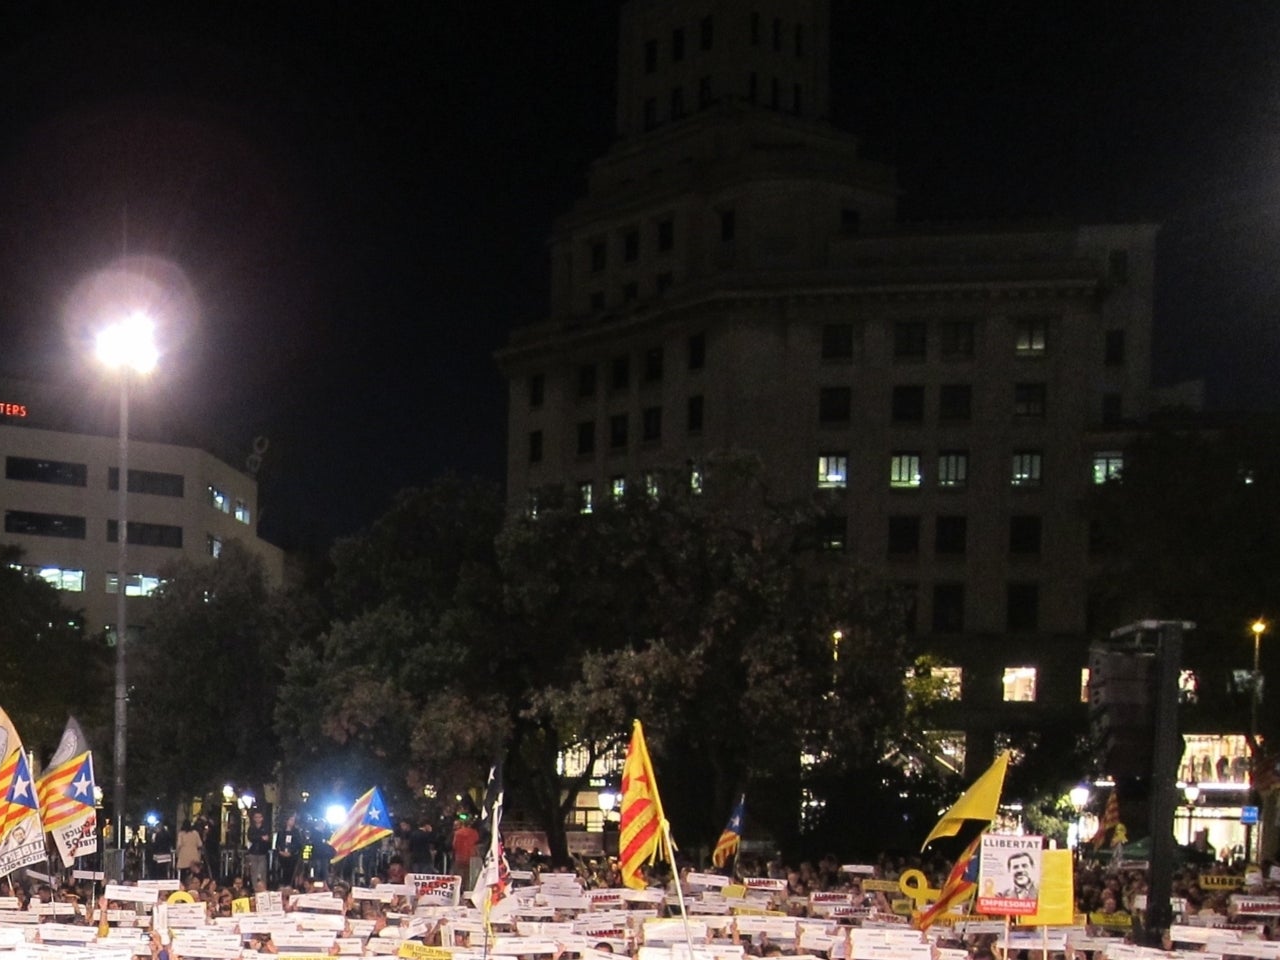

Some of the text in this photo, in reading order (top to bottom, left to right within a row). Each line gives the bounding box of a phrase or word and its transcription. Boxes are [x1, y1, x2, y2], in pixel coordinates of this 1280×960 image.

[983, 839, 1040, 849] LLIBERTAT
[414, 881, 455, 891] PRESOS
[980, 898, 1037, 909] EMPRESONAT
